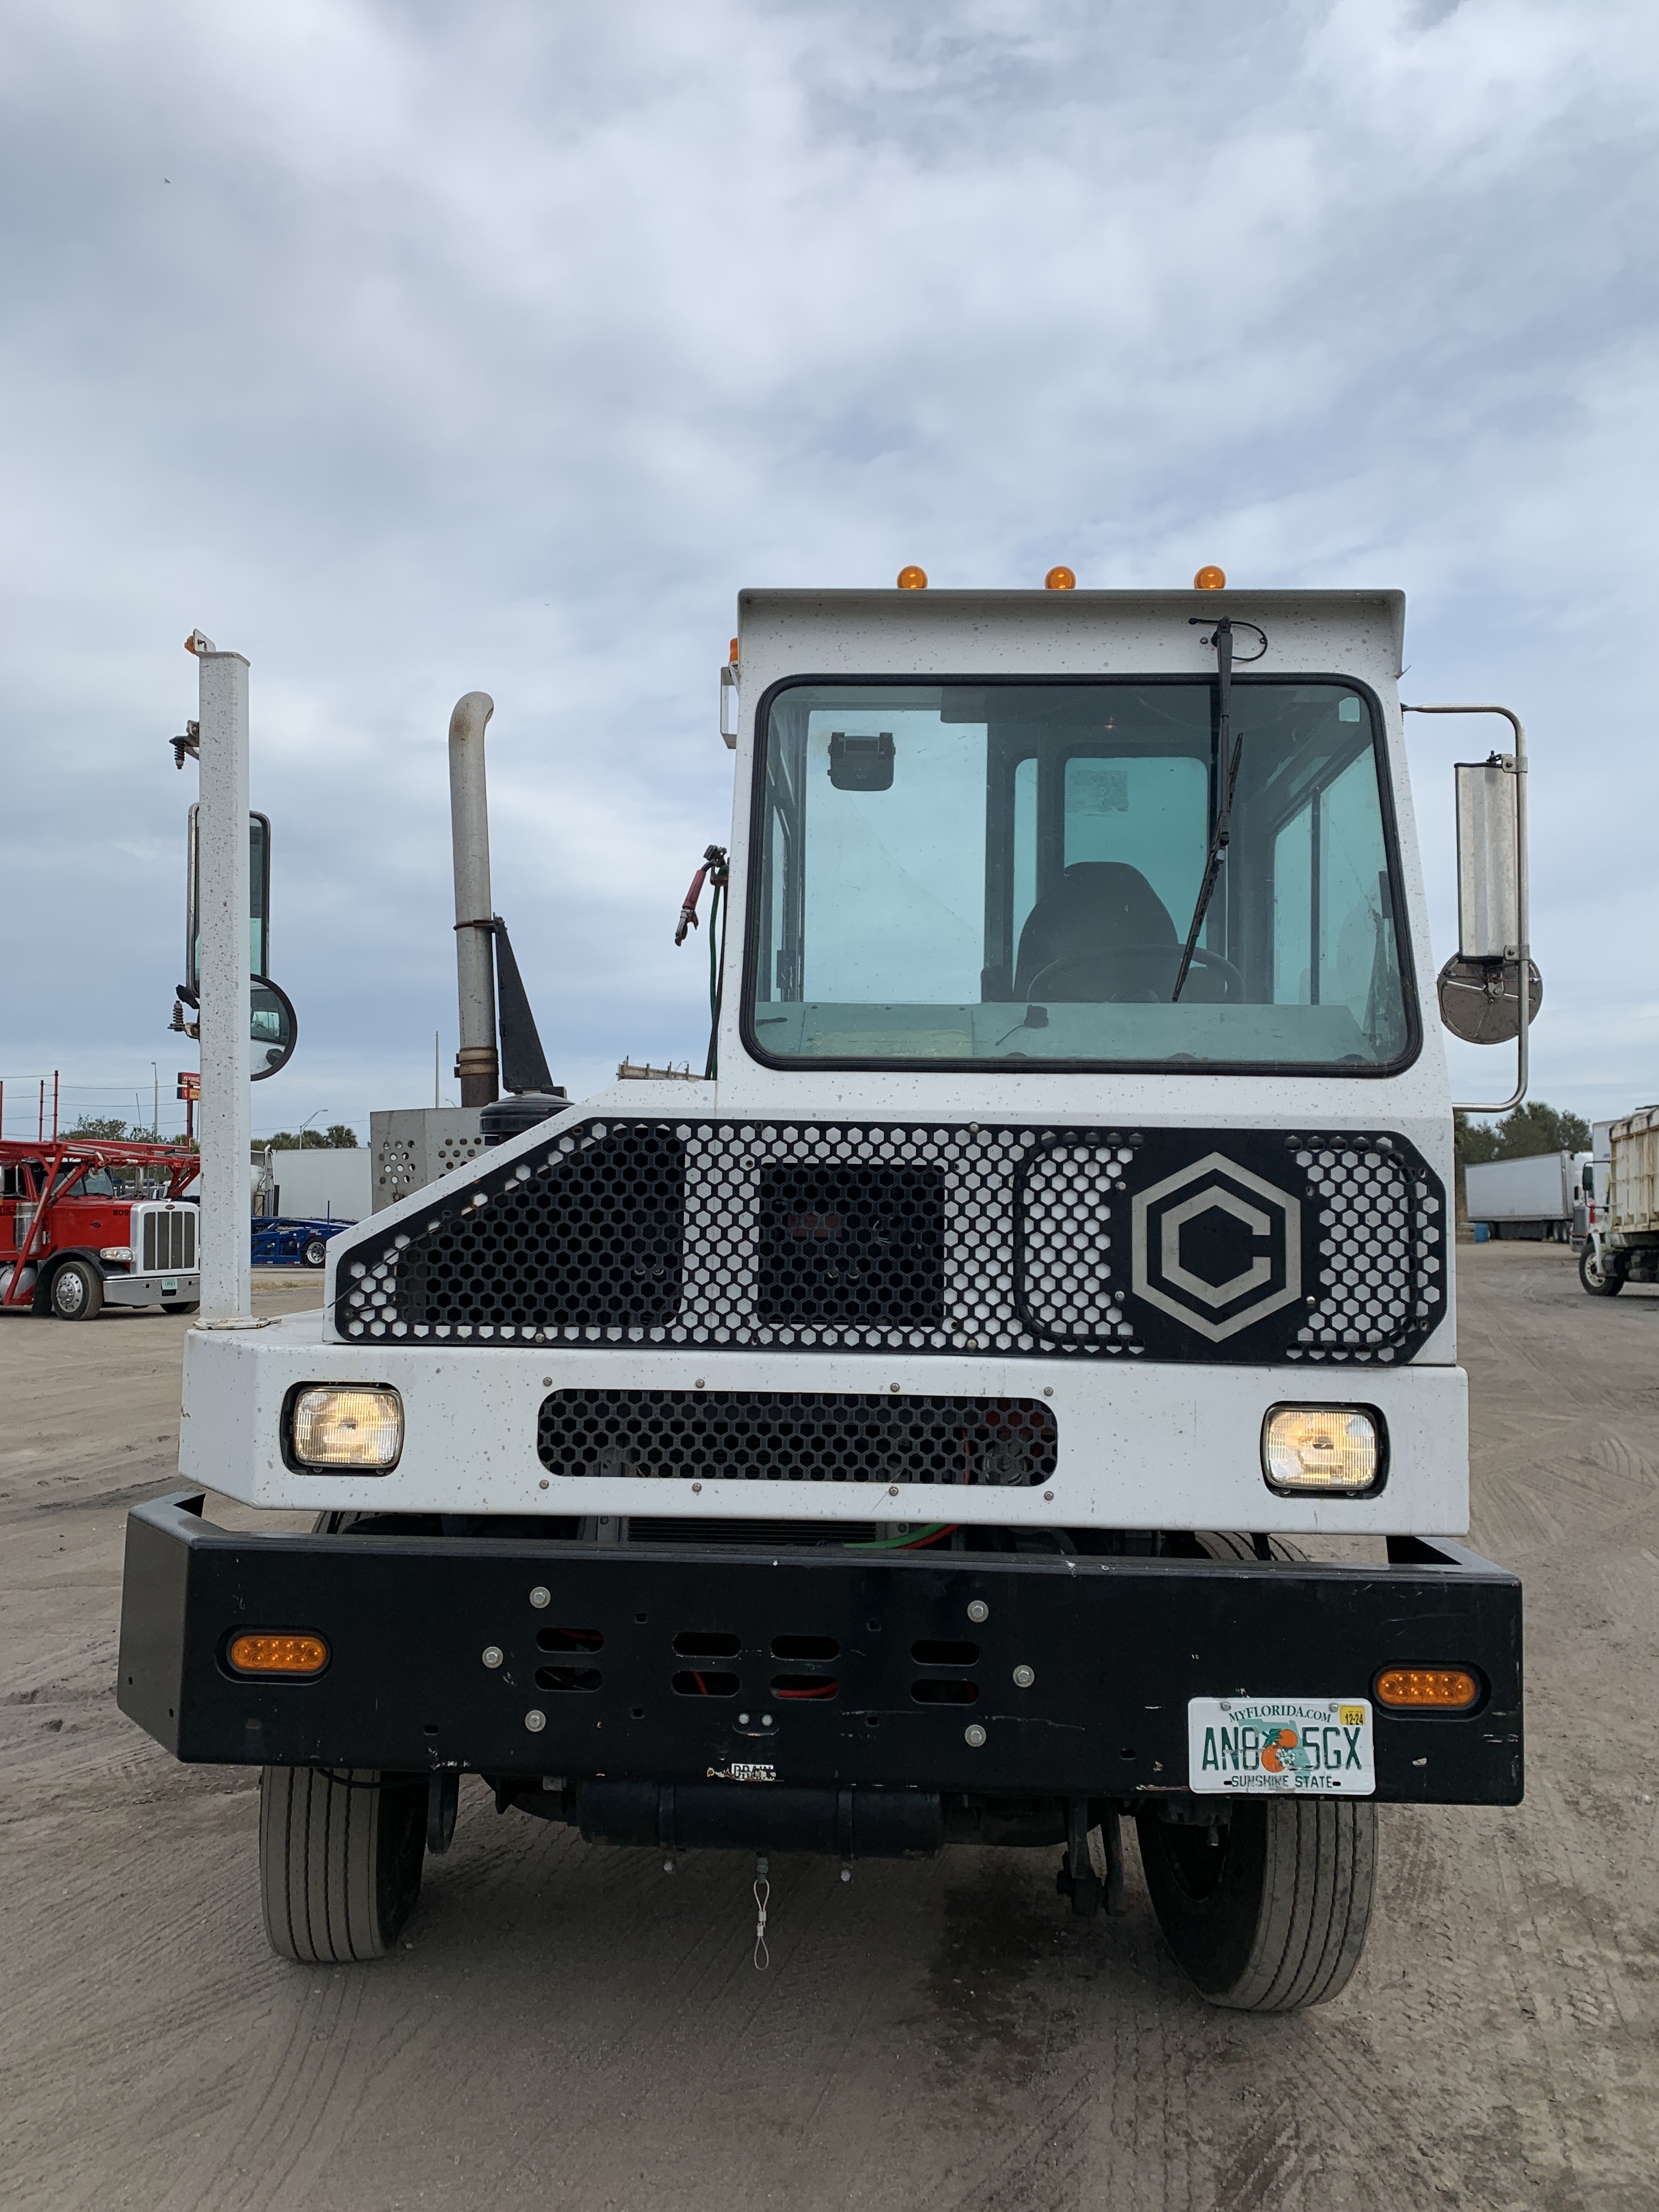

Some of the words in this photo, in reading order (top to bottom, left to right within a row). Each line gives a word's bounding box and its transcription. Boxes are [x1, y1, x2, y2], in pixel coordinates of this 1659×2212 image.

[1229, 1705, 1331, 1723] MYFLORIDA.COM
[1345, 1713, 1363, 1725] 12-24
[1232, 1775, 1289, 1787] SUNSHINE
[1295, 1775, 1333, 1788] STATE
